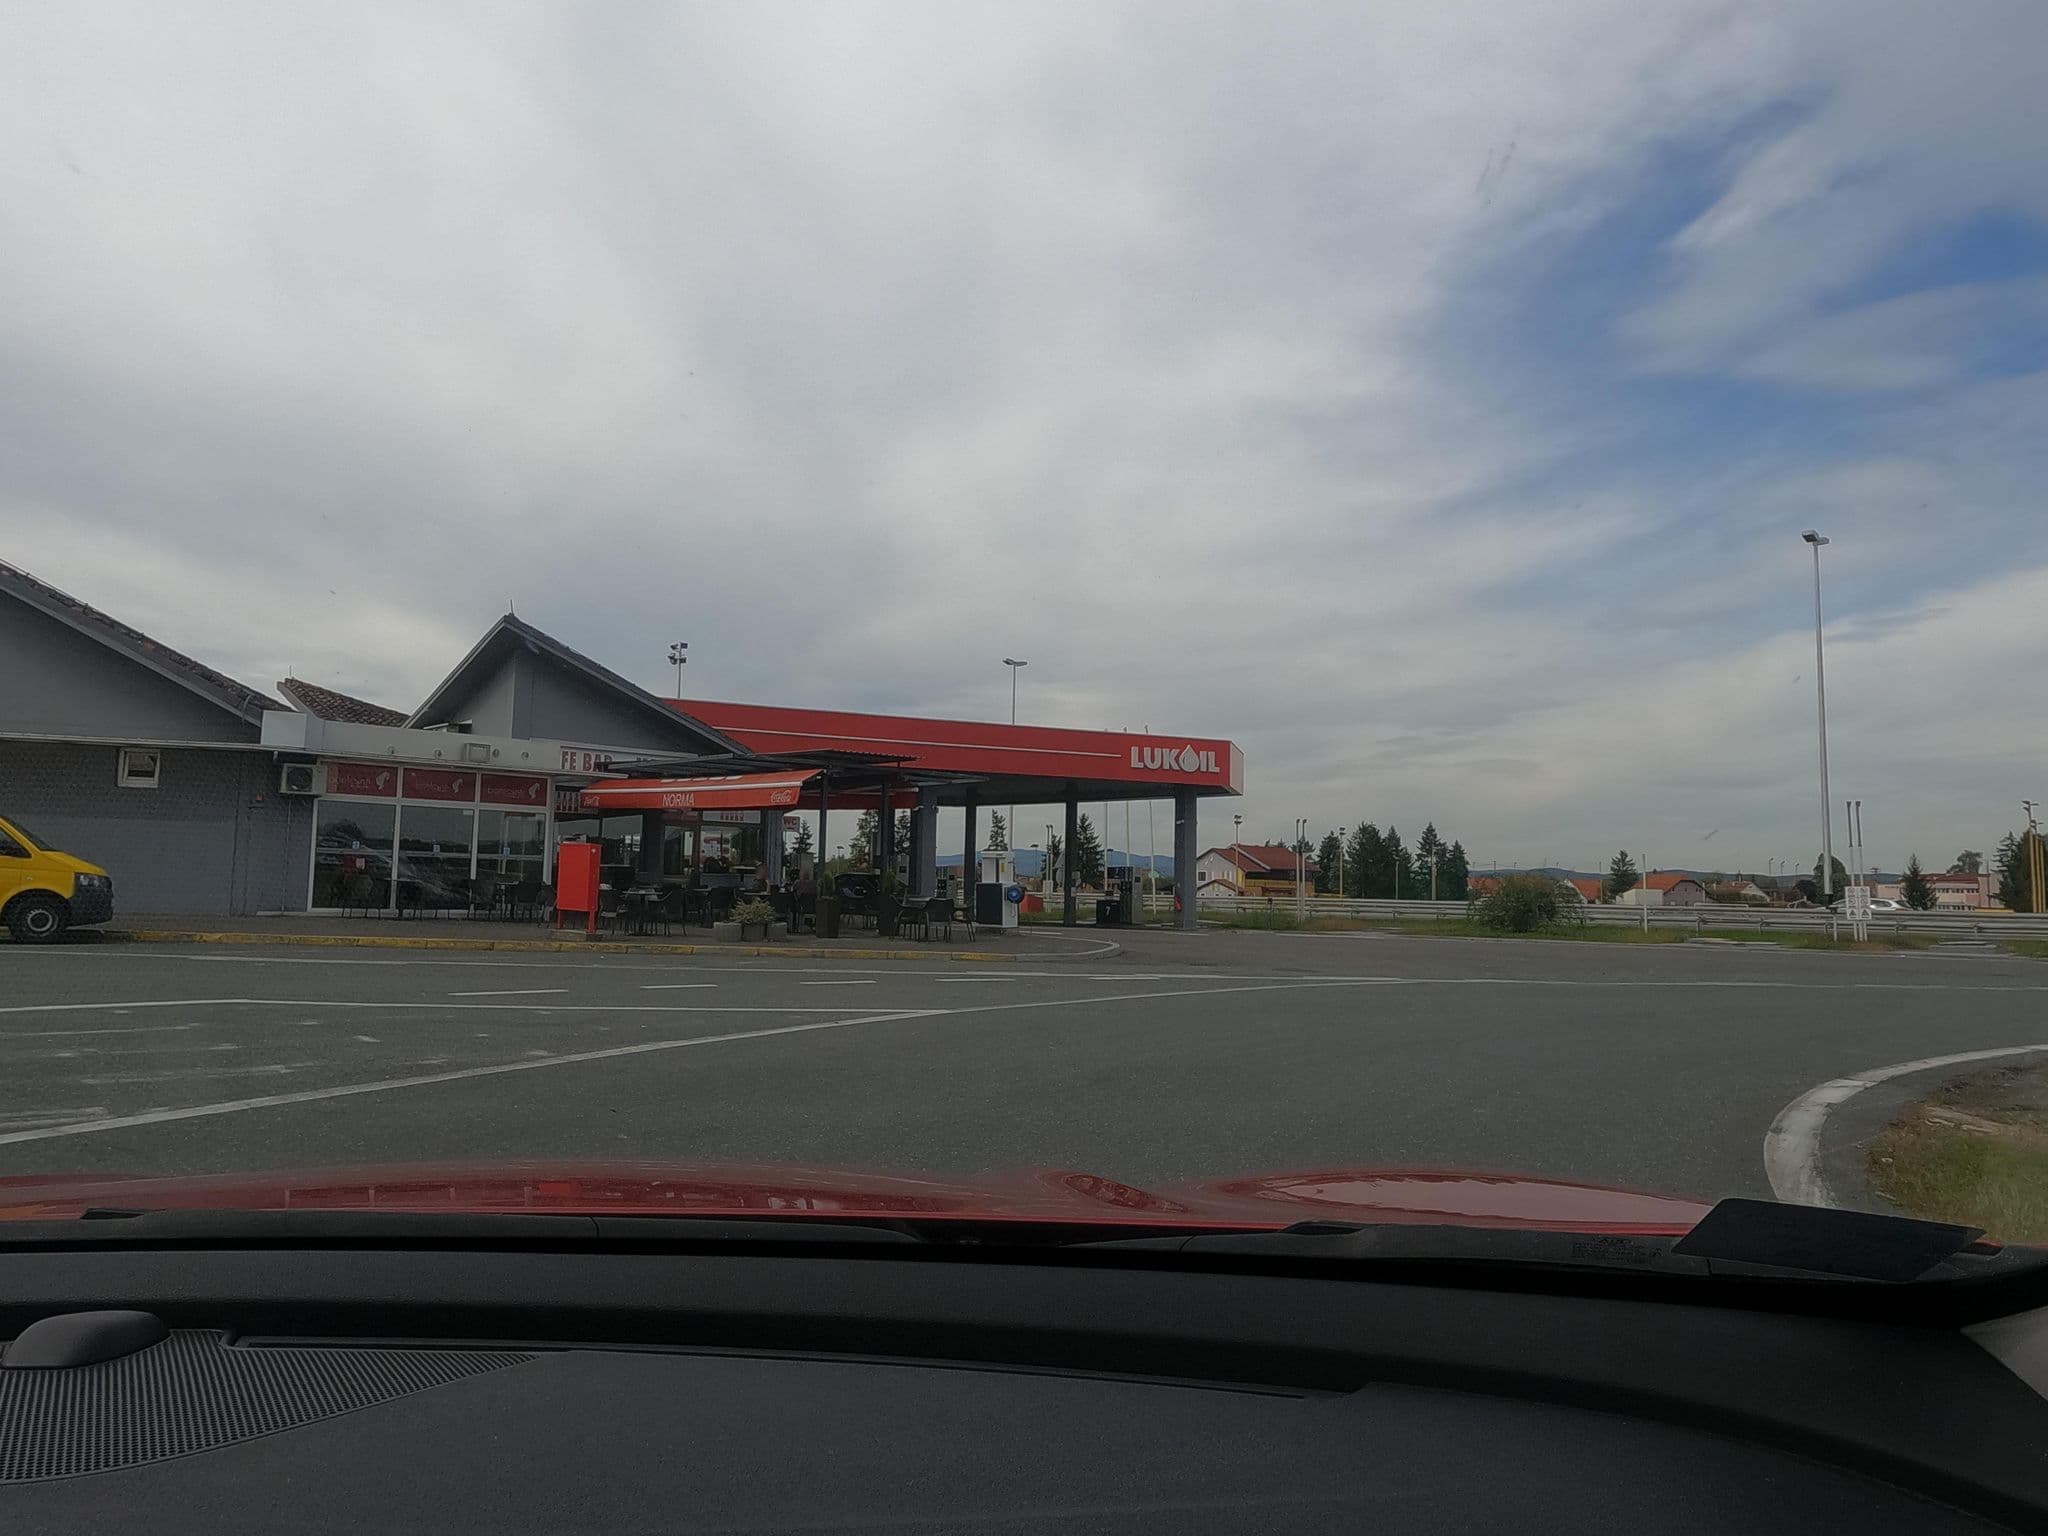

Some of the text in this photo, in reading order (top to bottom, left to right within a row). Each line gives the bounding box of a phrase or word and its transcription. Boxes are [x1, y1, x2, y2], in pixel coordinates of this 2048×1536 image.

[561, 750, 577, 770] FE
[1131, 744, 1220, 773] LUKOIL
[662, 793, 695, 807] NORMA
[784, 816, 797, 827] WC
[1105, 905, 1111, 916] 7
